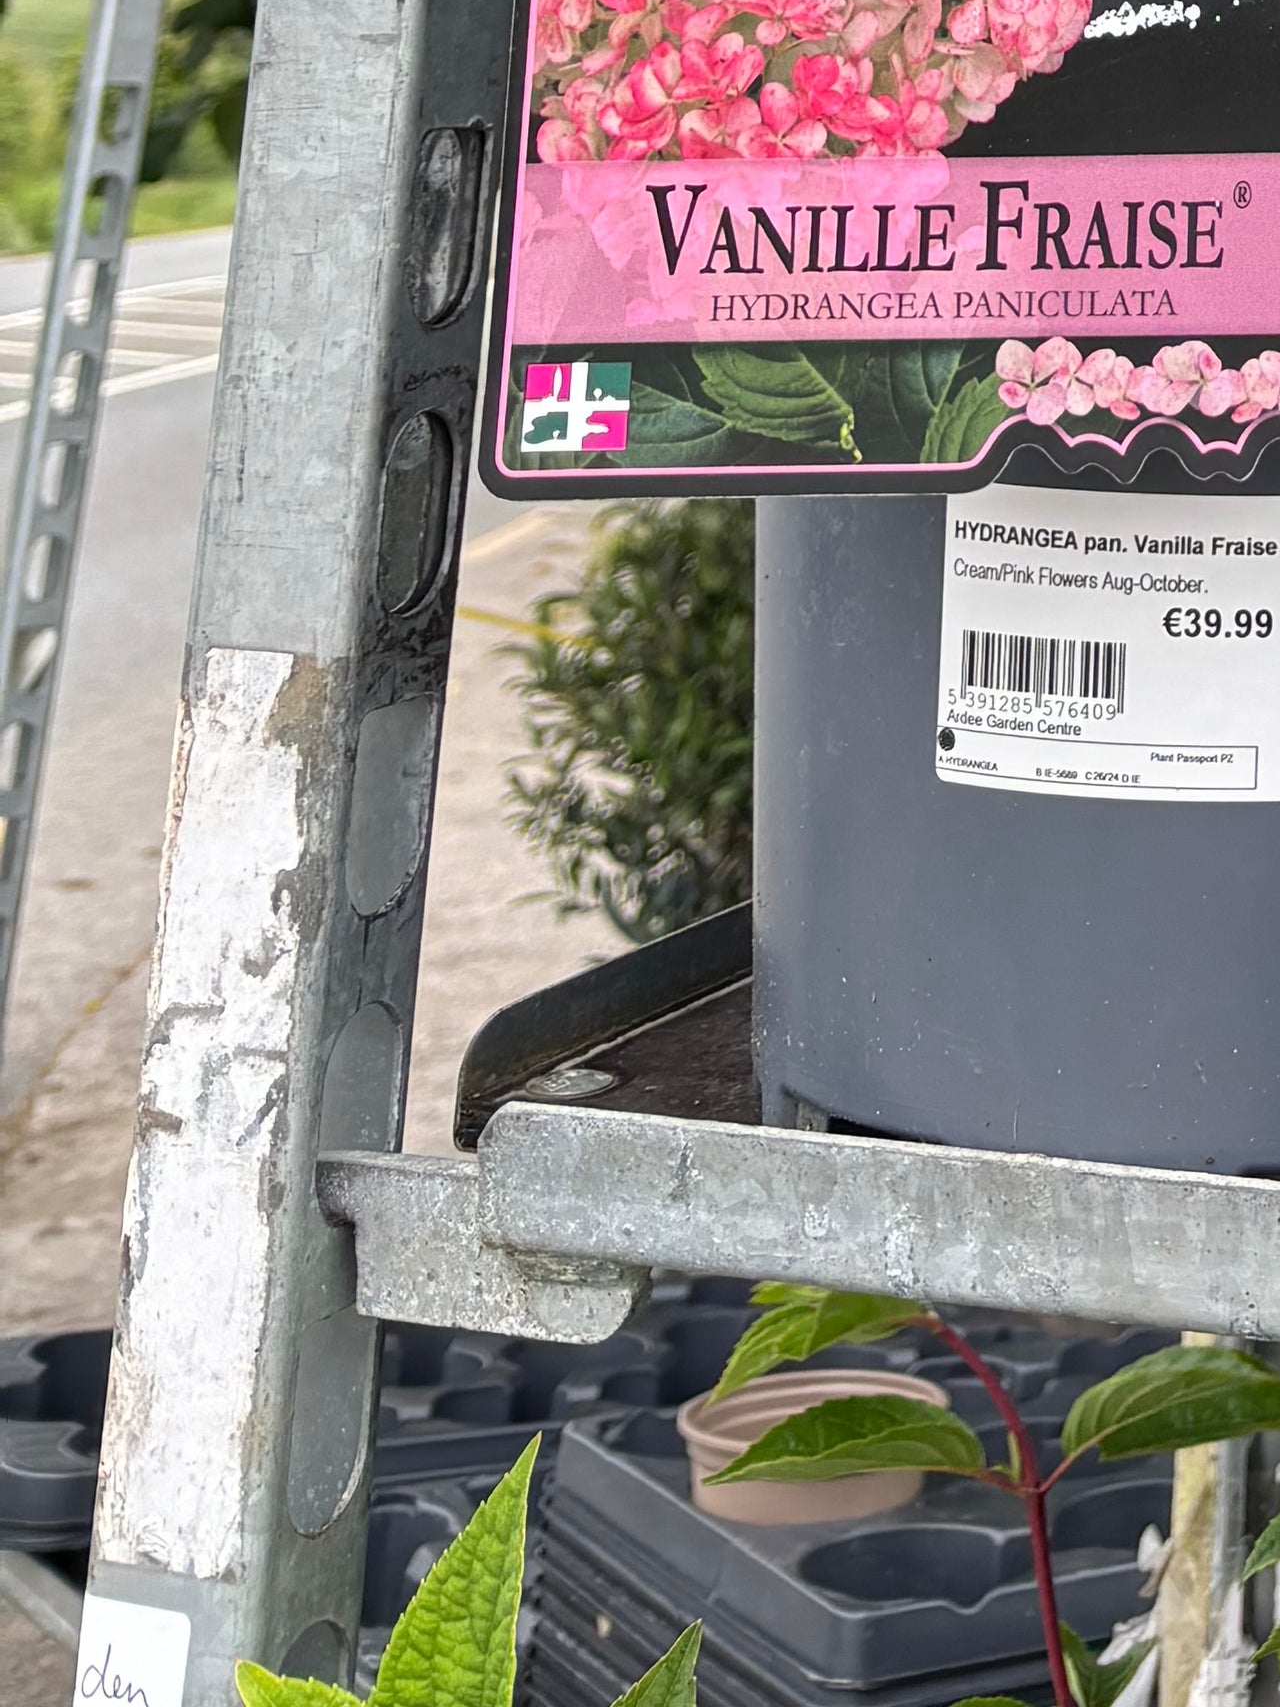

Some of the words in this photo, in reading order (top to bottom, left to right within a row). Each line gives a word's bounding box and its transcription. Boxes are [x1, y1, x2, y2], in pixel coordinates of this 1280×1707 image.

[645, 183, 956, 275] VANILLE
[709, 293, 942, 322] HYDRANGEA
[952, 289, 1179, 319] PANICULATA
[954, 519, 1078, 550] HYDRANGEA
[1083, 535, 1128, 555] pan.
[1133, 535, 1204, 555] Vanilla
[1211, 537, 1279, 556] Fraise
[953, 557, 1035, 585] Cream/Pink
[1038, 567, 1098, 589] Flowers
[1101, 571, 1209, 595] Aug-October.
[1162, 607, 1273, 639] €39.99
[966, 691, 1033, 714] 391285
[1043, 700, 1117, 720] 576409
[947, 709, 983, 726] Ardee
[986, 714, 1034, 732] Garden
[1037, 719, 1082, 736] Centre
[946, 756, 998, 772] HYDRANGEA
[1150, 752, 1174, 762] Plant
[1177, 753, 1218, 764] Passport
